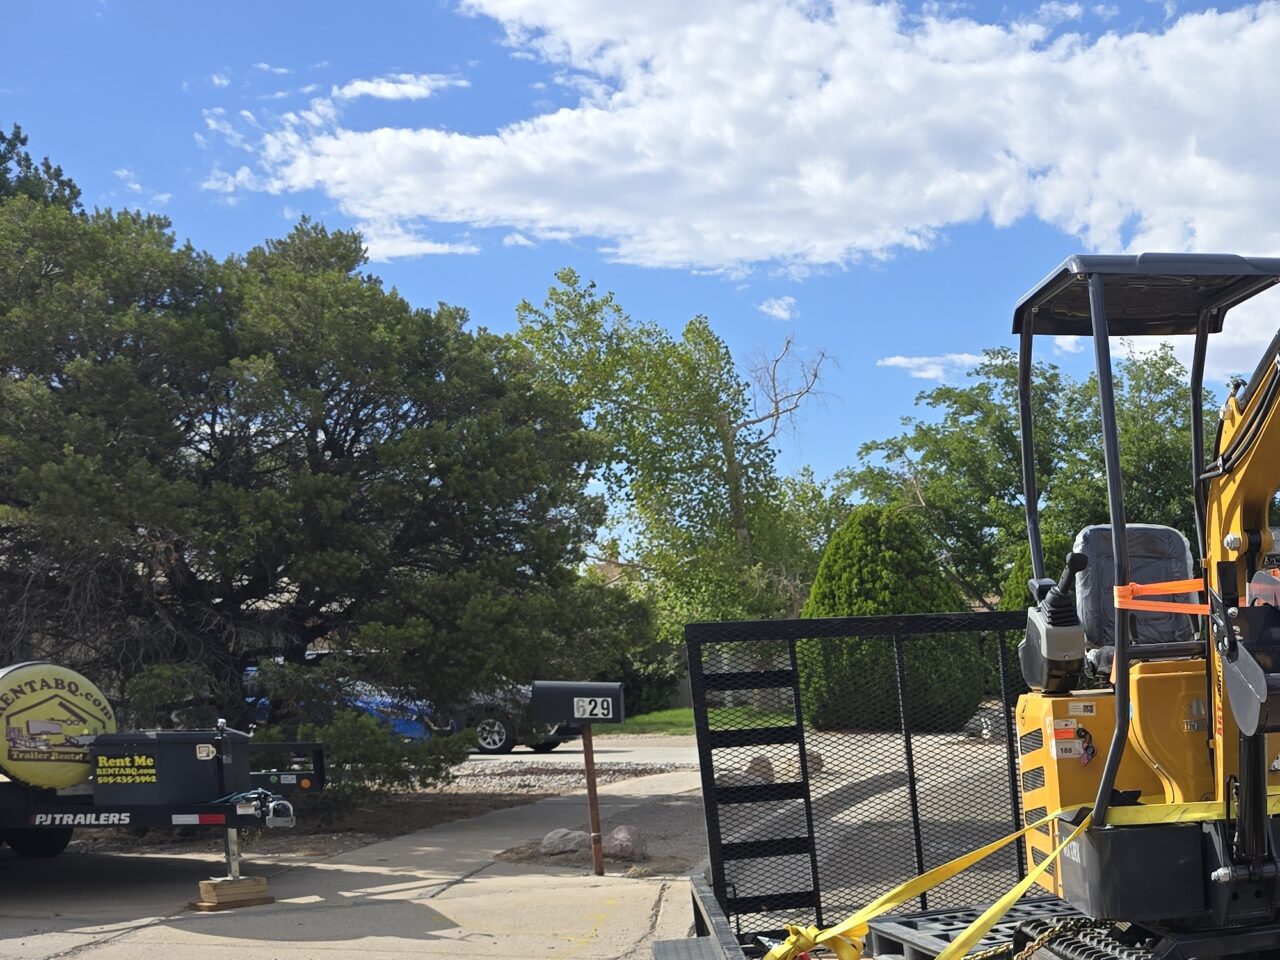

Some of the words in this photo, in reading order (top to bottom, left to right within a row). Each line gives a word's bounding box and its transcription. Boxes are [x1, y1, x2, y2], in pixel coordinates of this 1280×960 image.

[575, 698, 612, 717] 629
[10, 751, 50, 760] Trailer
[52, 752, 83, 760] Rental
[98, 756, 131, 767] Rent
[134, 755, 154, 766] Me
[96, 767, 156, 775] RENTABQ.com
[97, 775, 157, 784] 505-235-3962
